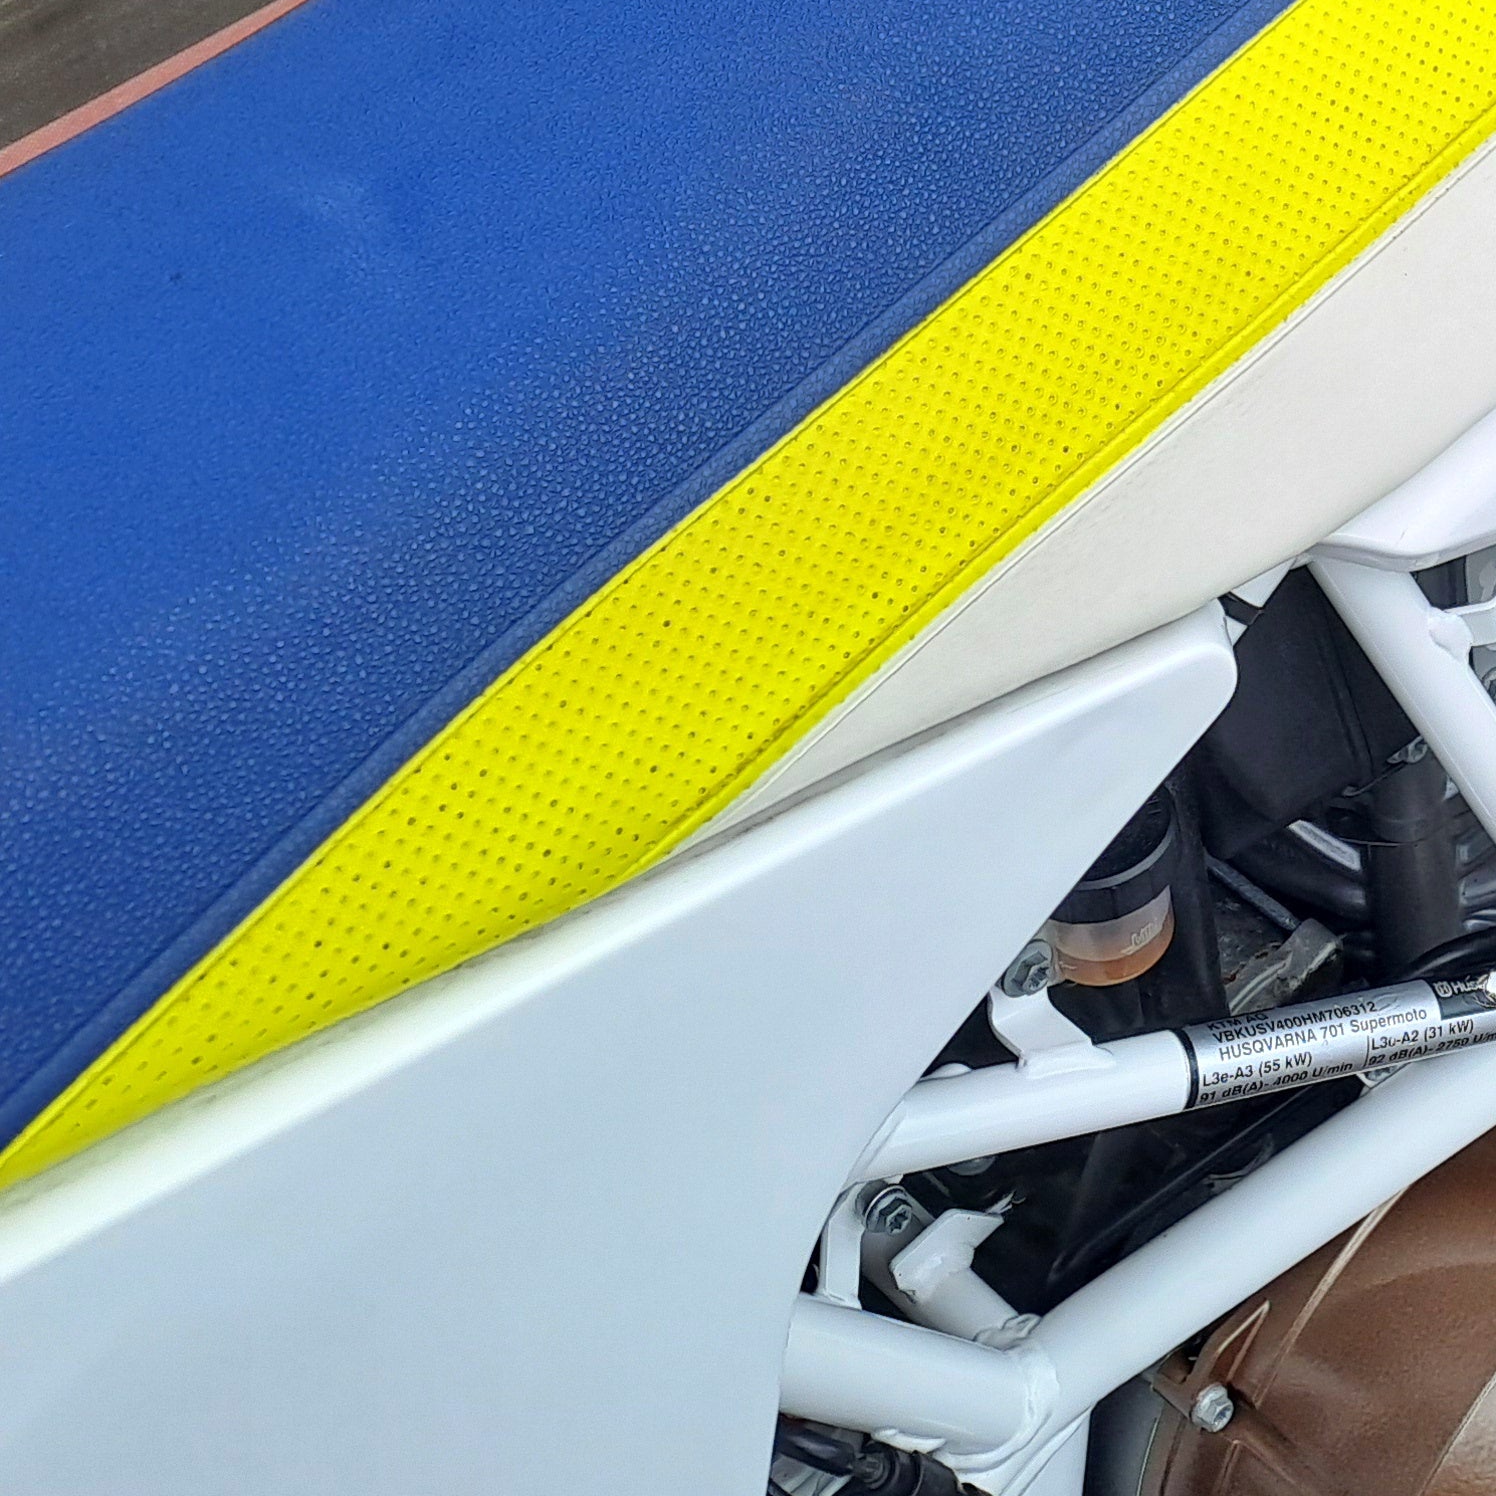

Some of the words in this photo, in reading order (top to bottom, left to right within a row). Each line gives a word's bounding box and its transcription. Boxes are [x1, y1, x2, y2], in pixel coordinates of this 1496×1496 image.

[1219, 1029, 1318, 1061] HUSQVARNA
[1320, 1023, 1345, 1040] 701
[1350, 1008, 1428, 1034] Supermoto
[1424, 1025, 1443, 1043] (31
[1449, 1019, 1474, 1035] kW)
[1200, 1092, 1216, 1102] 91
[1272, 1072, 1308, 1087] 4000
[1313, 1062, 1353, 1078] U/min
[1202, 1065, 1254, 1088] L3e-A3
[1259, 1060, 1281, 1078] (55
[1286, 1051, 1313, 1068] kW)
